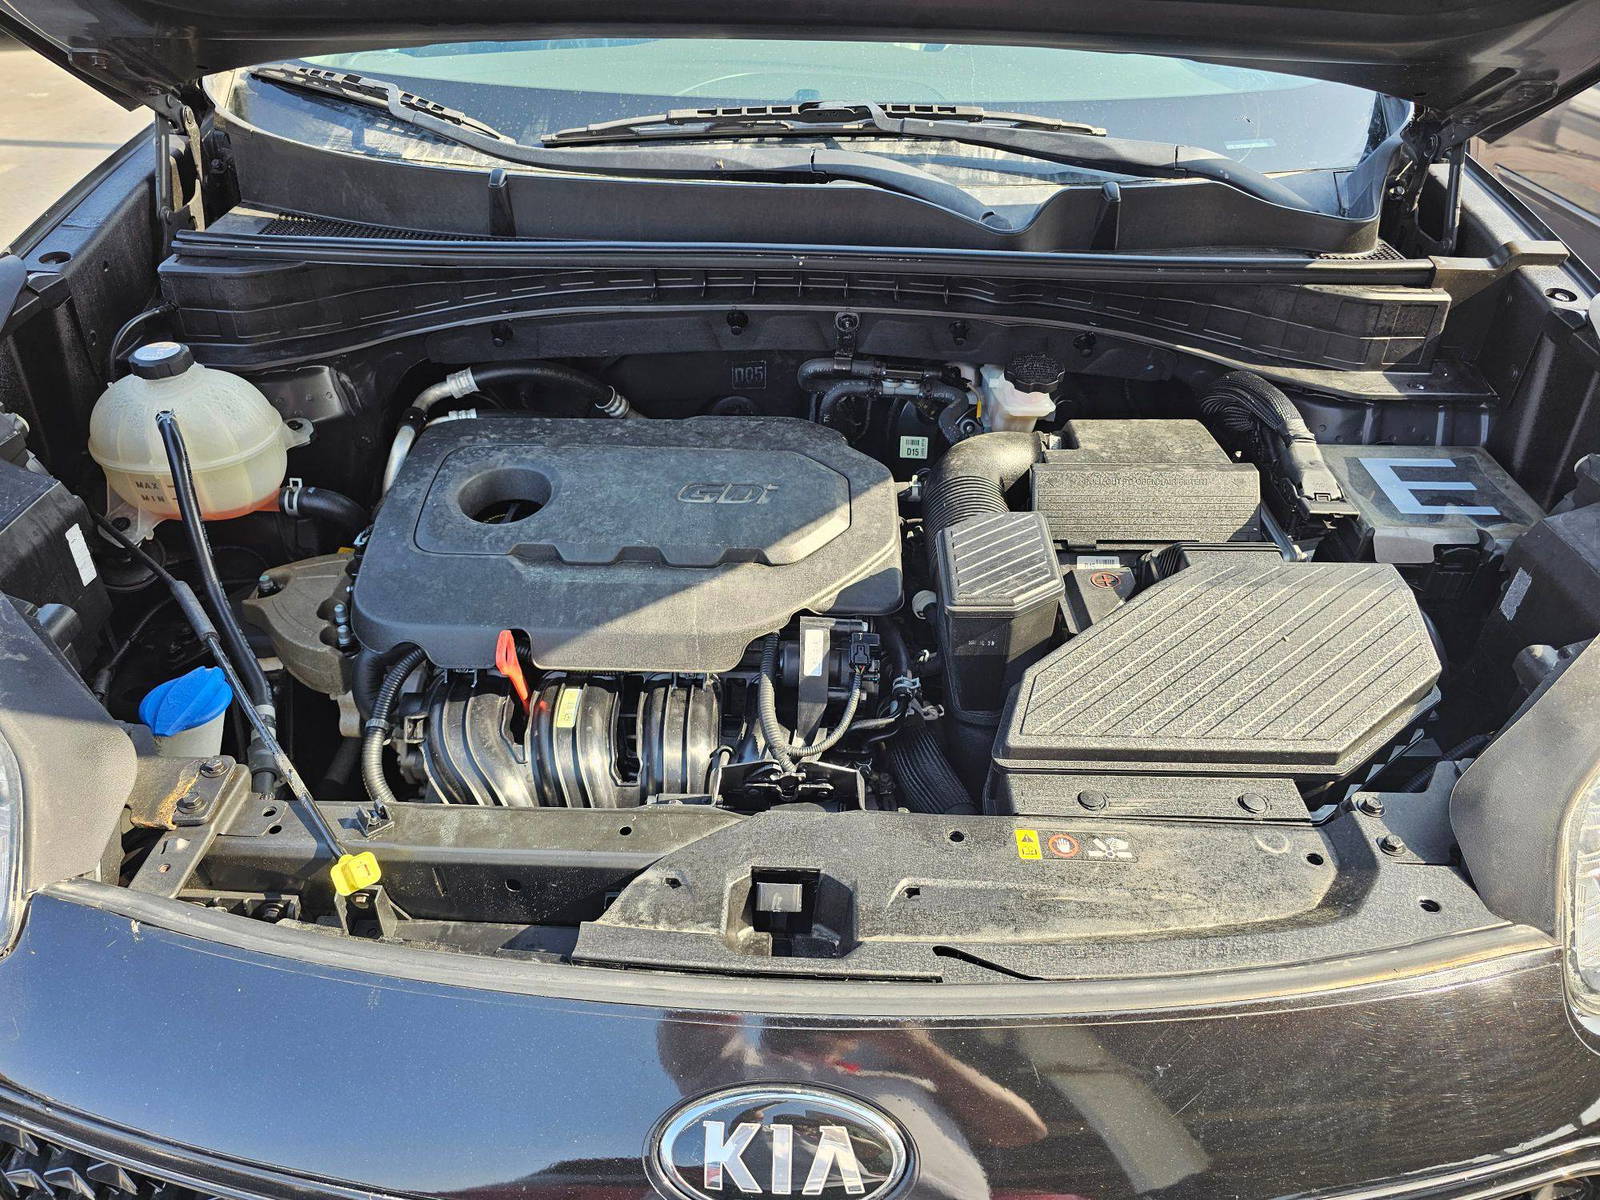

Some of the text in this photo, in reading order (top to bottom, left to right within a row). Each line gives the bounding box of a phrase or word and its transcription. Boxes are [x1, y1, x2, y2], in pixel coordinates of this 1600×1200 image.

[906, 447, 920, 456] D15
[135, 481, 160, 489] MAX
[140, 494, 165, 502] MIN
[702, 1120, 866, 1196] KIA
